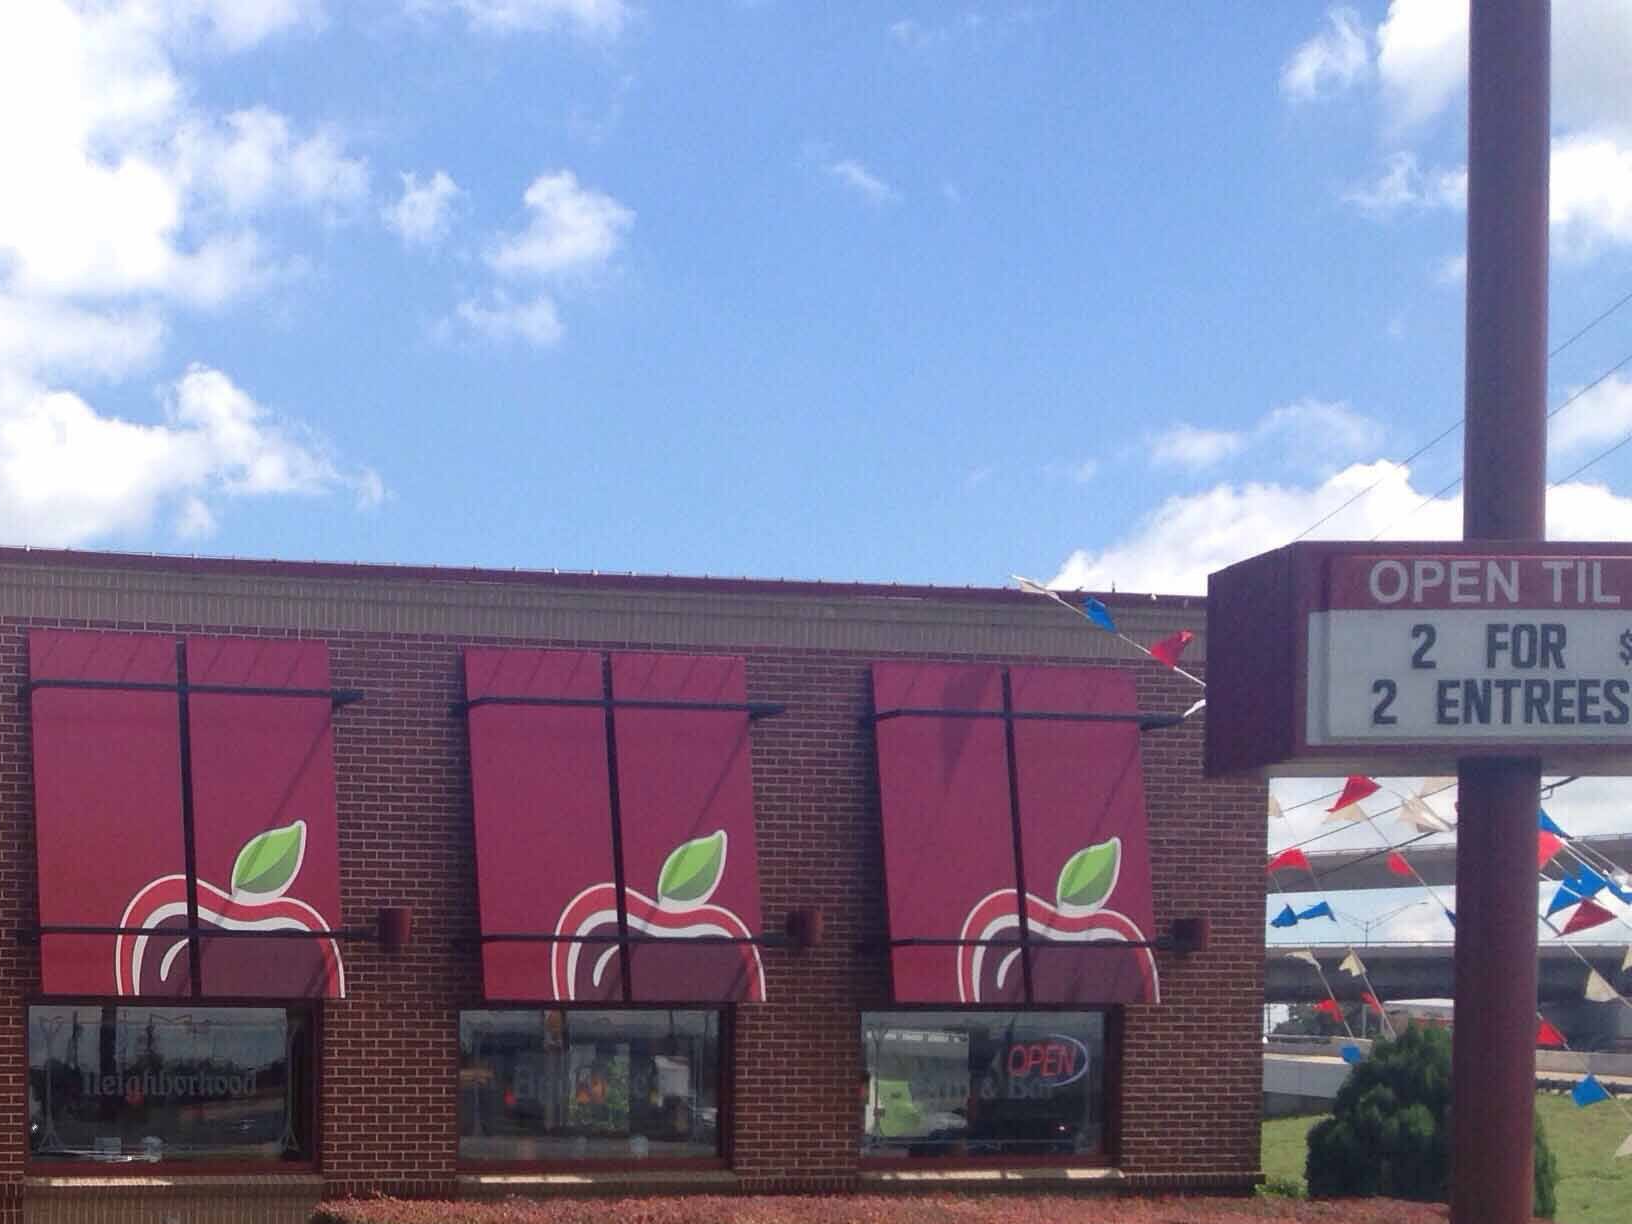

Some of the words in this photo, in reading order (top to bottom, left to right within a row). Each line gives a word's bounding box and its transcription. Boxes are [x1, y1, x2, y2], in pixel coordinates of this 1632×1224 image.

[1369, 560, 1520, 603] OPEN
[1542, 561, 1621, 603] TIL
[1411, 624, 1438, 669] 2
[1486, 623, 1567, 669] FOR
[1372, 679, 1398, 724] 2
[1437, 679, 1630, 724] ENTREES
[1008, 1043, 1078, 1077] OPEN
